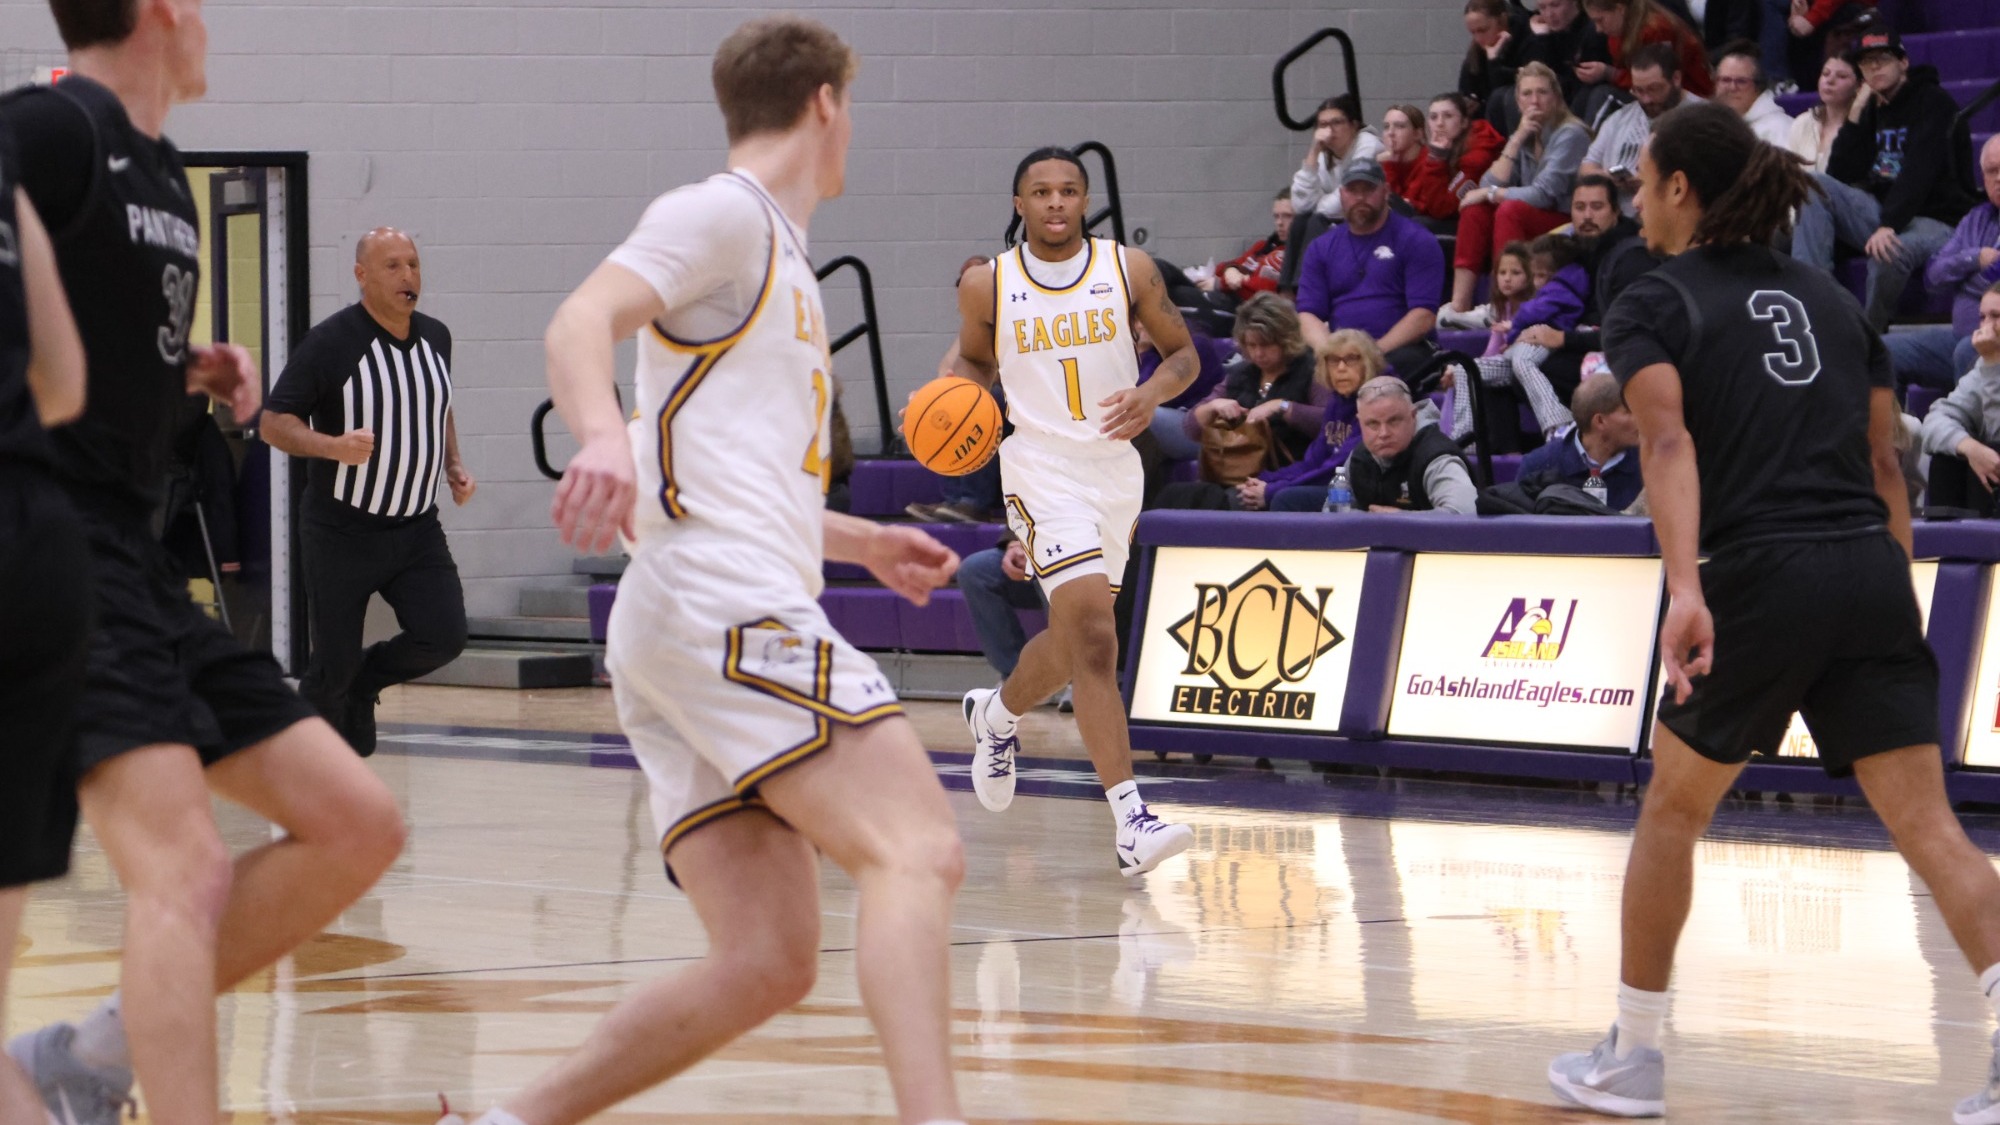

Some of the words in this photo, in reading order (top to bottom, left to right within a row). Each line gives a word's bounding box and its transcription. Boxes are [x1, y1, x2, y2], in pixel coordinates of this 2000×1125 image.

[1013, 308, 1116, 354] EAGLES
[1746, 290, 1821, 385] 3
[1058, 357, 1087, 420] 1
[801, 368, 831, 495] 2
[1180, 582, 1334, 683] BCU
[1487, 640, 1560, 660] ASHLAND
[1176, 687, 1308, 718] ELECTRIC
[1406, 674, 1635, 707] GoAshlandEagles.com
